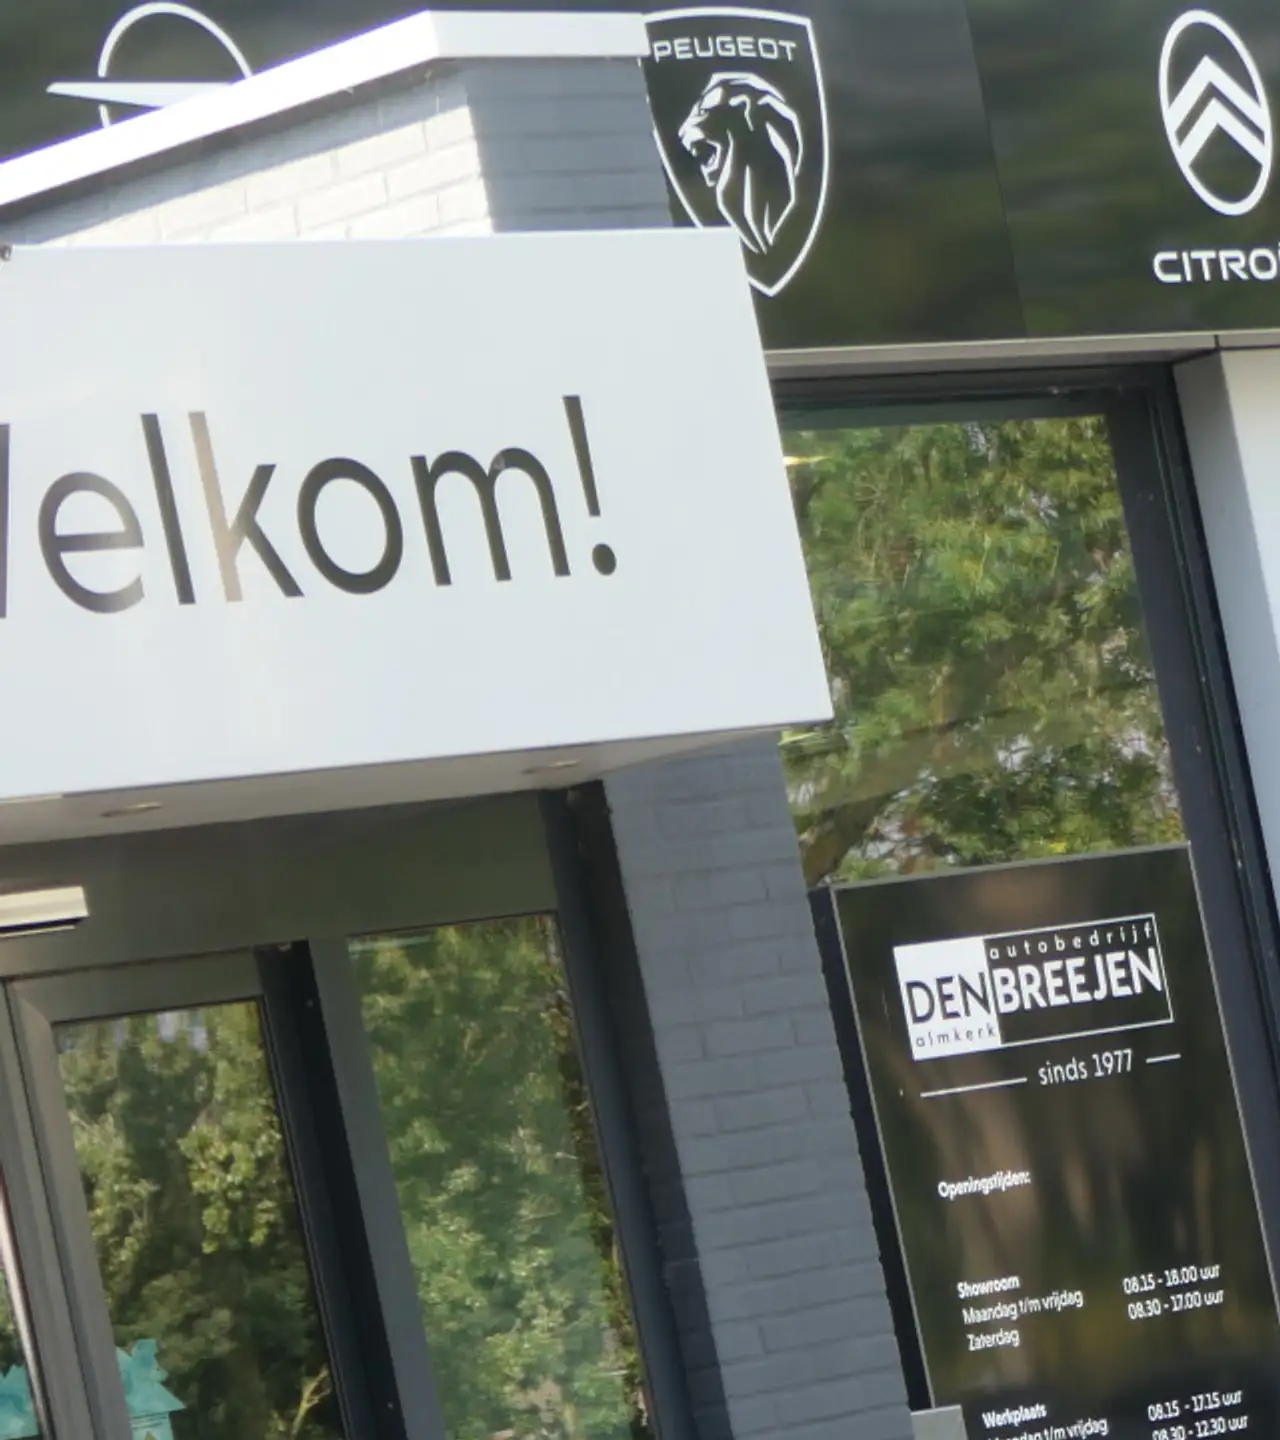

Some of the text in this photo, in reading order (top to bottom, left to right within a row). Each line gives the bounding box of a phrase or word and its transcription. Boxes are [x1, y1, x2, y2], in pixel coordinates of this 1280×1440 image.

[652, 35, 797, 63] PEUGEOT
[0, 394, 617, 618] elkom!
[989, 921, 1153, 960] autobedrijf
[905, 947, 1163, 1025] DEN BREEJEN
[915, 1024, 998, 1048] almkerk
[1039, 1049, 1133, 1086] sinds 1977
[957, 1275, 1020, 1299] Showroom
[962, 1301, 1018, 1324] Maandag
[1018, 1297, 1042, 1313] t/m
[1042, 1290, 1083, 1312] vrijdag
[1122, 1273, 1156, 1295] 08.15
[1164, 1265, 1198, 1287] 18.00
[1199, 1264, 1221, 1280] uur
[966, 1329, 1020, 1351] Zaterdag
[1127, 1298, 1161, 1320] 08.30
[1170, 1291, 1202, 1312] 17.00
[1203, 1290, 1224, 1306] uur
[982, 1402, 1047, 1429] Werkplaats
[1066, 1418, 1109, 1440] vrijdag
[1147, 1400, 1180, 1422] 08.15
[1191, 1392, 1220, 1413] 17.15
[1222, 1390, 1243, 1406] uur
[1194, 1416, 1226, 1438] 12.30
[1227, 1415, 1249, 1431] uur
